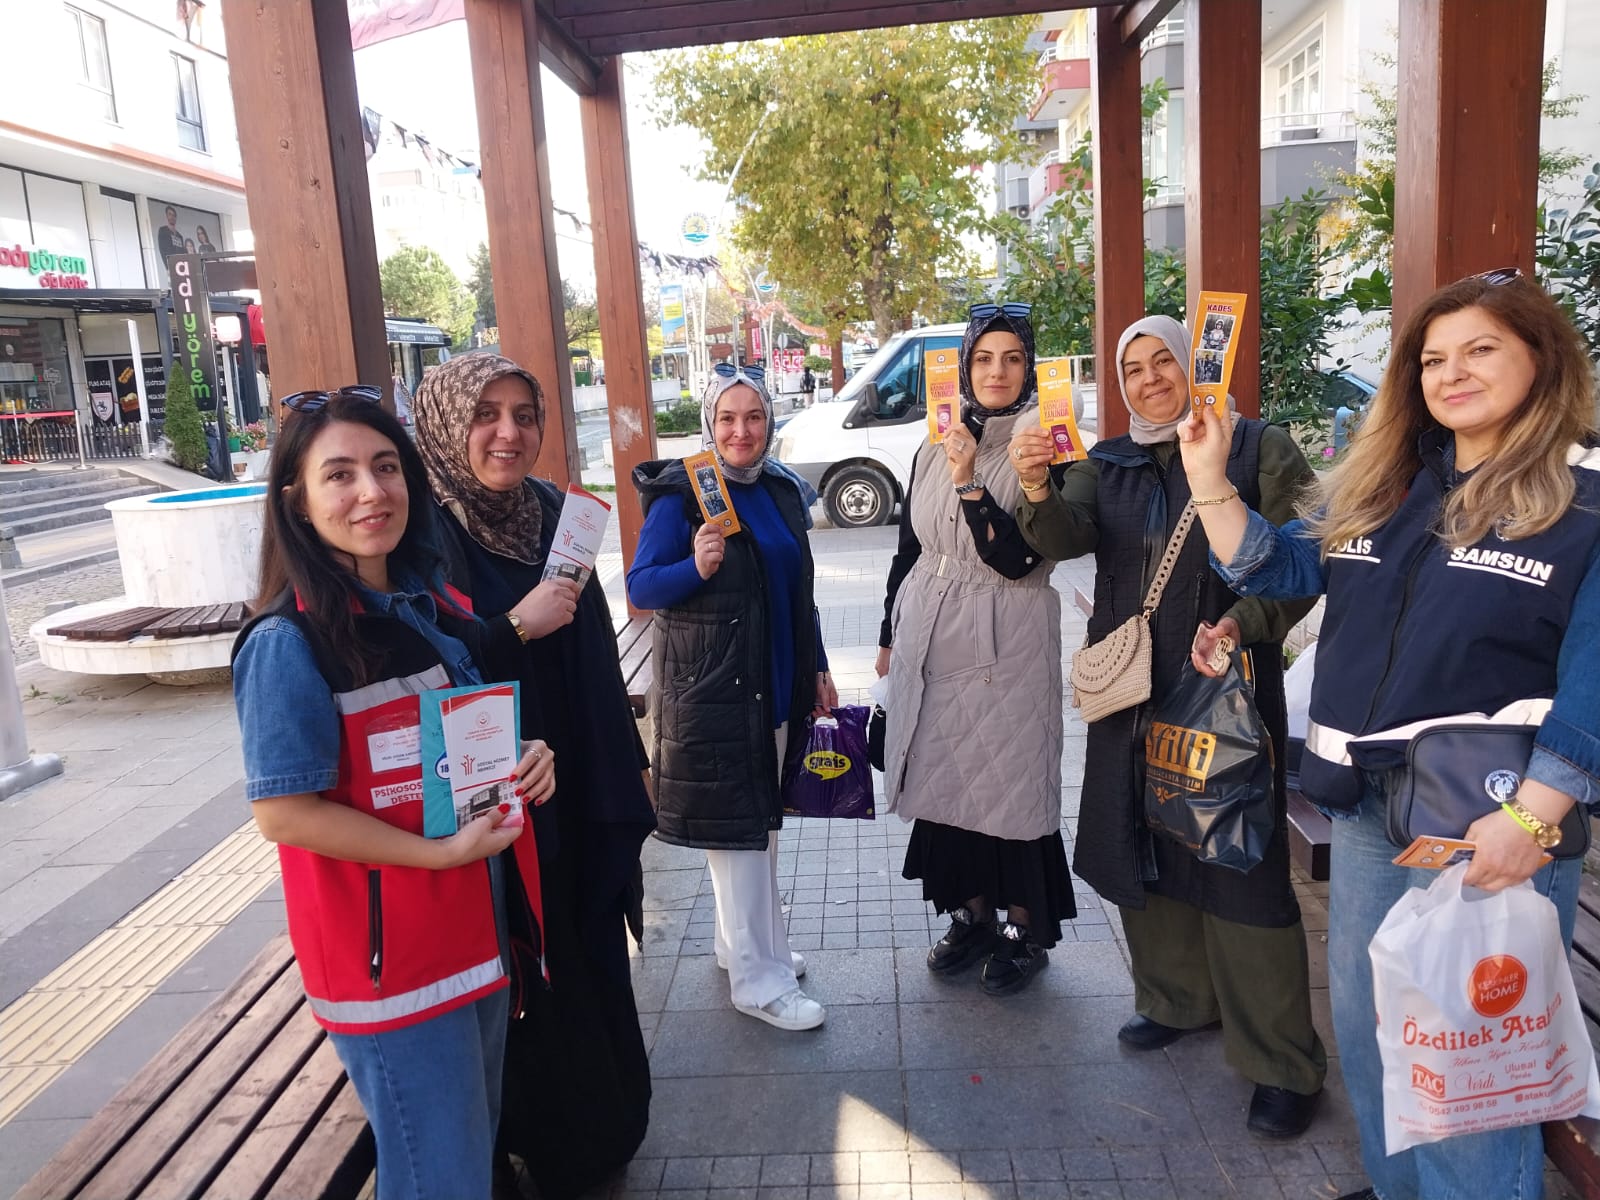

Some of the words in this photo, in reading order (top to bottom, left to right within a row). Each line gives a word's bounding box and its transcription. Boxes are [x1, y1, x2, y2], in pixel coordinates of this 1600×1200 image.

[1207, 304, 1232, 313] KADES
[1450, 546, 1554, 581] SAMSUN
[391, 793, 424, 805] DESTE
[1480, 981, 1519, 1004] HOME
[1403, 1015, 1494, 1051] Özdilek
